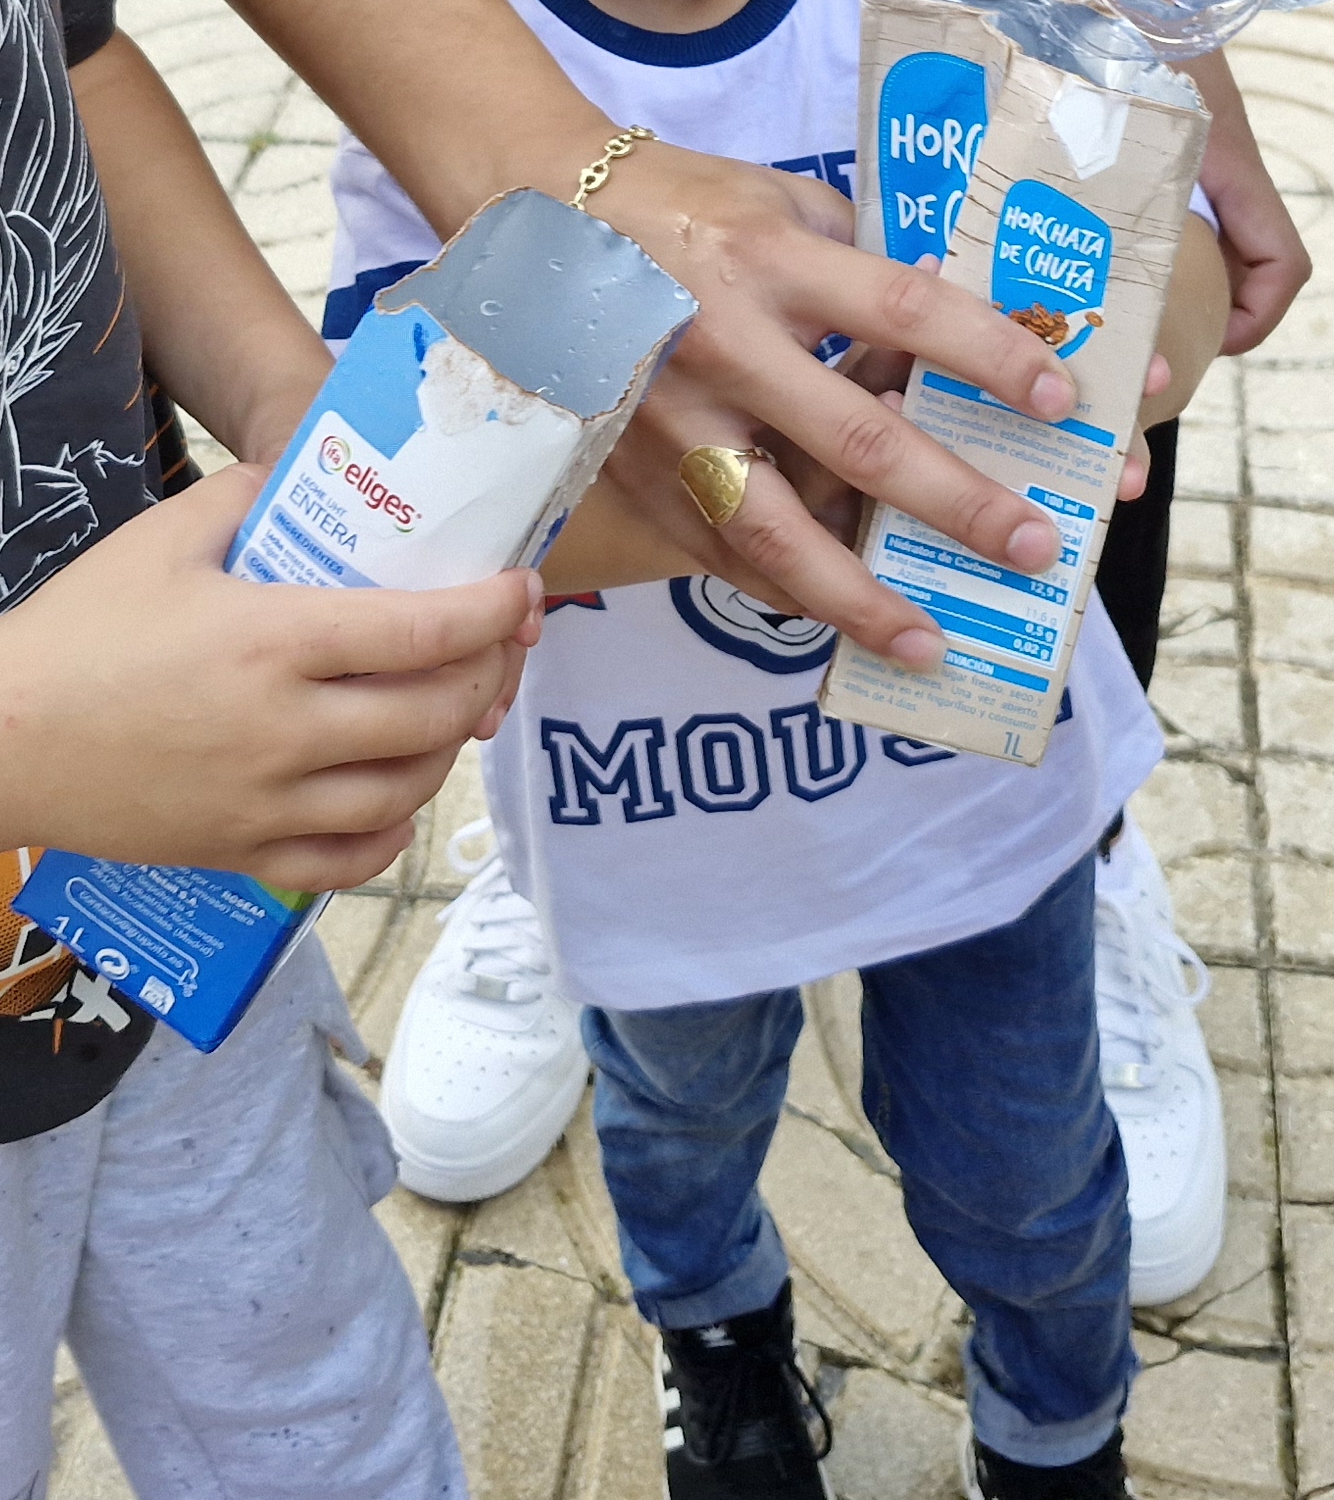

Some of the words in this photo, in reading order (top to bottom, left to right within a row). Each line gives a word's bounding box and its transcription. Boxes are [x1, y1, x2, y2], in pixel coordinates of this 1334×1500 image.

[895, 191, 938, 235] DE
[1003, 205, 1106, 260] HORCHATA
[999, 240, 1024, 266] DE
[1025, 244, 1095, 293] CHUFA
[288, 483, 360, 554] ENTERA
[343, 462, 416, 526] eliges
[888, 537, 937, 559] Hidratos
[938, 552, 953, 563] de
[953, 558, 1002, 579] Carbono
[1028, 581, 1054, 598] 12,9
[1054, 591, 1064, 602] g
[1024, 623, 1044, 636] 0,5
[946, 651, 995, 675] RVACIÓN
[541, 700, 959, 825] MOU
[1003, 731, 1024, 759] 1L
